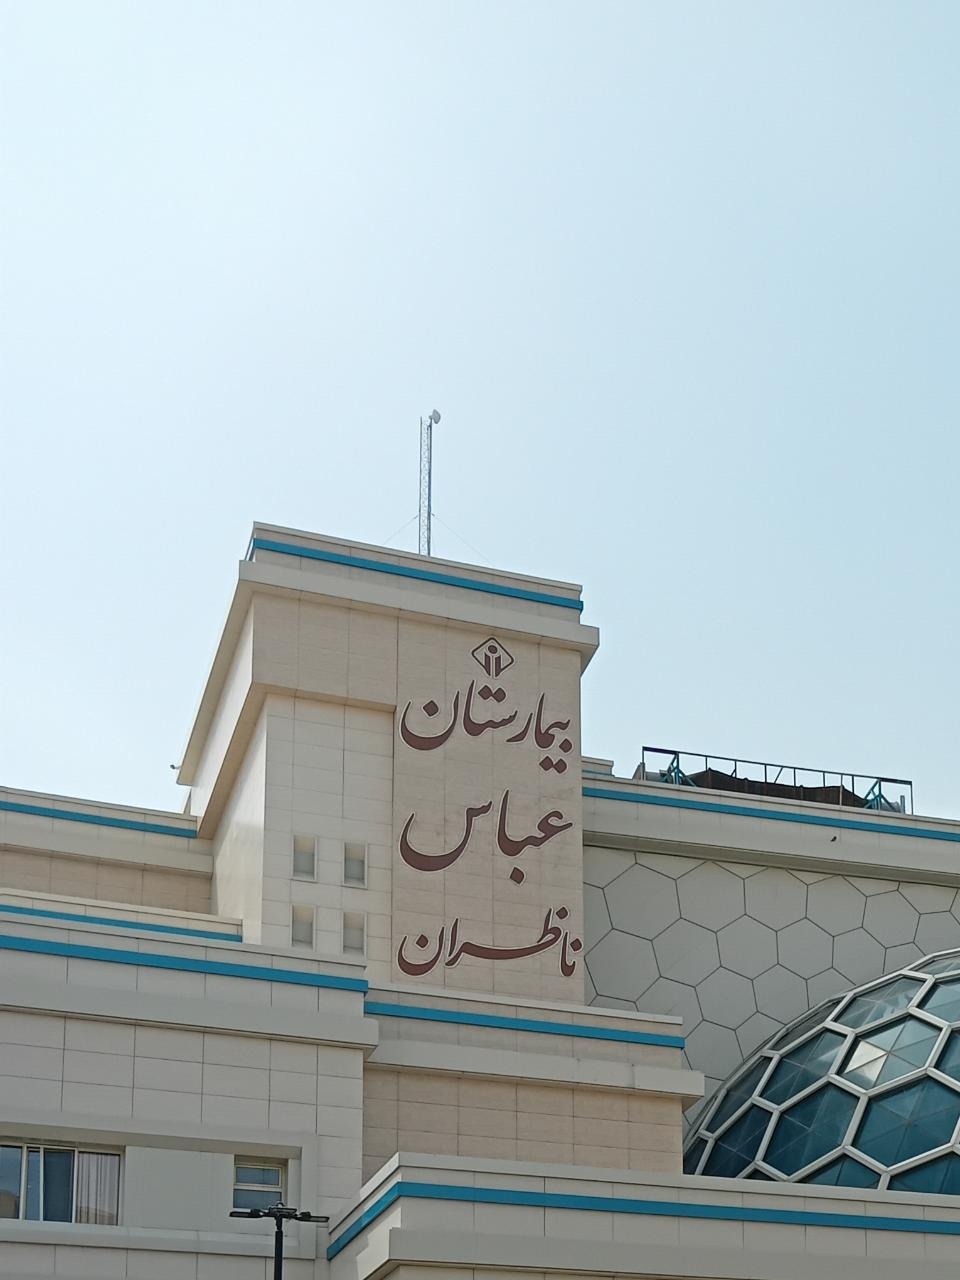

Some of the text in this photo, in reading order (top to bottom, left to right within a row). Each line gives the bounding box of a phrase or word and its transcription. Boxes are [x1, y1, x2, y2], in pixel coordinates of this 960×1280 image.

[400, 680, 573, 774] بیمارستان
[399, 789, 574, 885] عباس
[397, 906, 583, 977] ناظران
